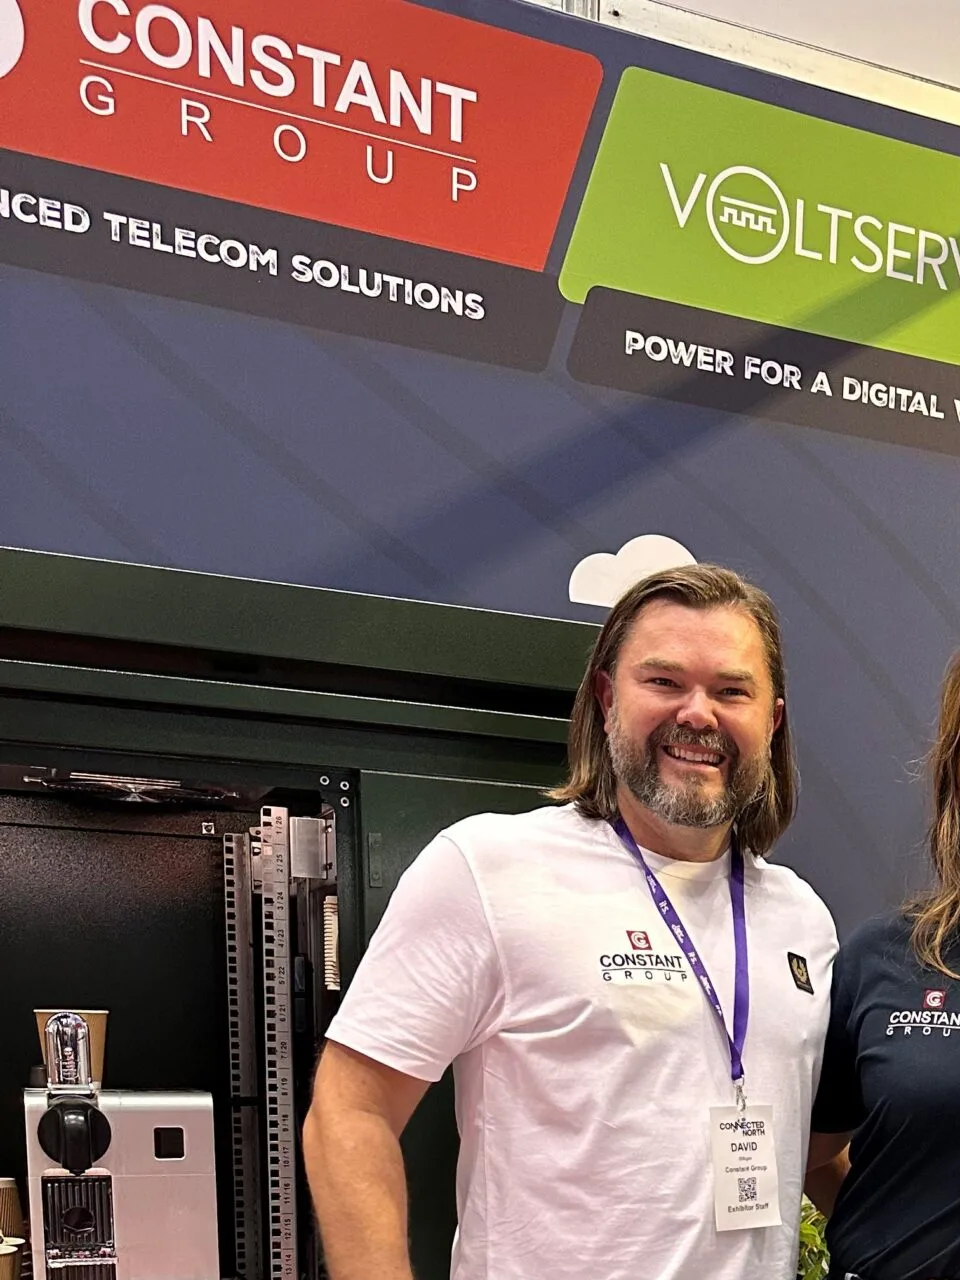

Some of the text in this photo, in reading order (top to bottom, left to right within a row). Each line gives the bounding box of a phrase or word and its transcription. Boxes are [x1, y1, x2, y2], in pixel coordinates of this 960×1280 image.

[78, 0, 477, 143] CONSTANT
[78, 75, 478, 202] GROUP
[103, 211, 278, 276] TELECOM
[290, 254, 485, 321] SOLUTIONS
[625, 330, 734, 377] POWER
[744, 356, 801, 390] FOR
[810, 371, 832, 396] A
[842, 376, 944, 420] DIGITAL
[599, 954, 683, 969] CONSTANT
[602, 970, 687, 982] GROUP
[719, 1120, 765, 1132] CONNECTED
[742, 1129, 766, 1137] NORTH
[730, 1142, 758, 1152] DAVID
